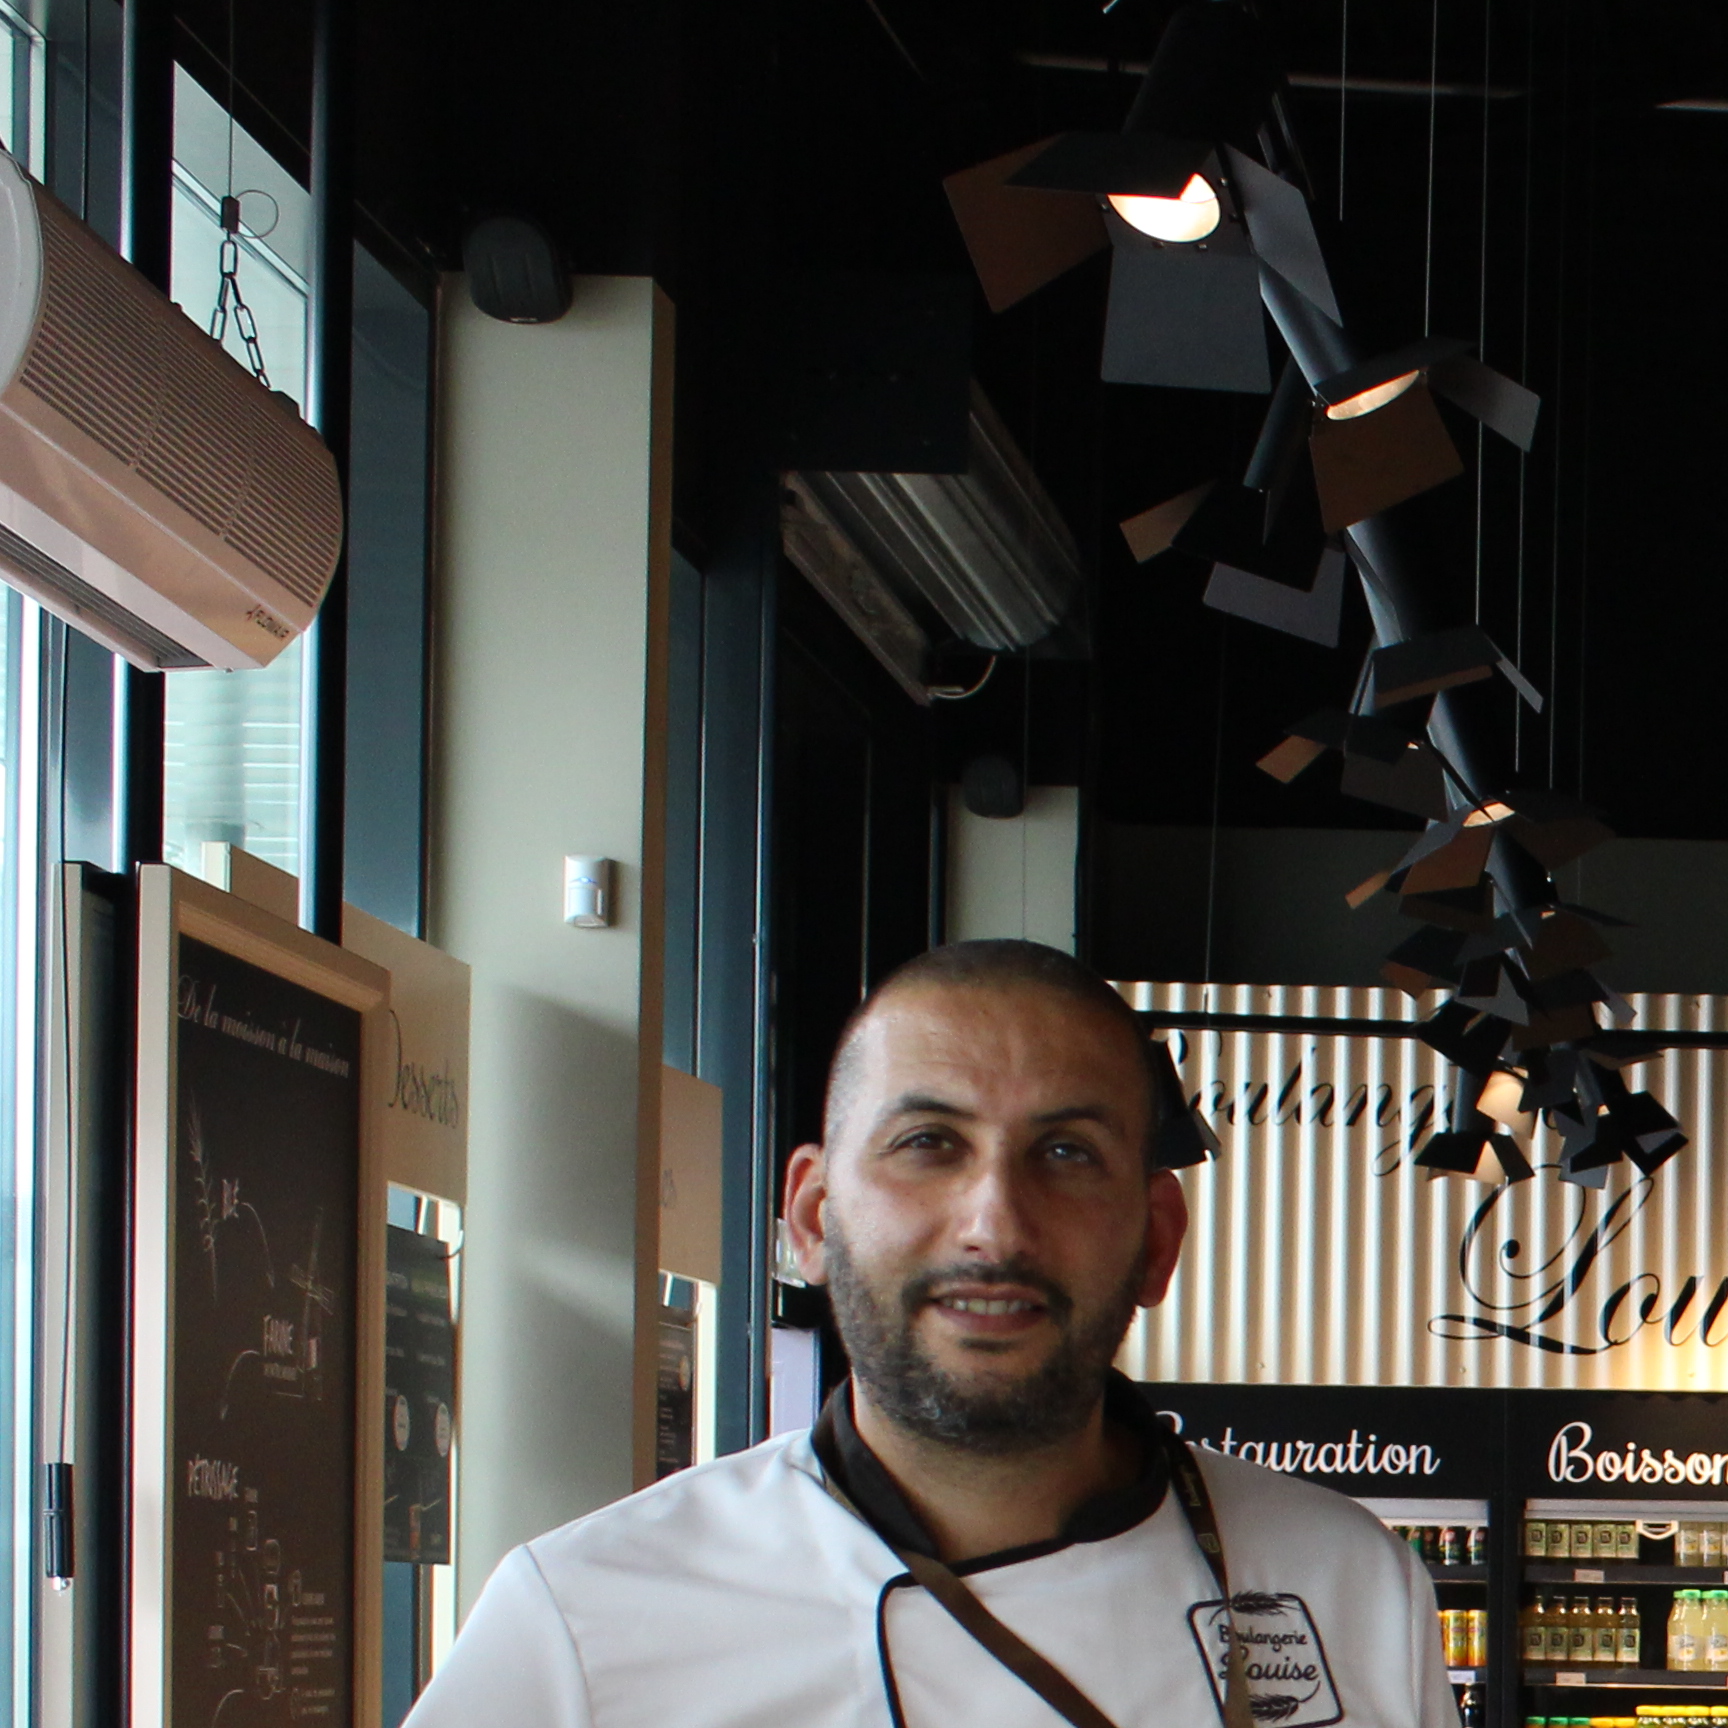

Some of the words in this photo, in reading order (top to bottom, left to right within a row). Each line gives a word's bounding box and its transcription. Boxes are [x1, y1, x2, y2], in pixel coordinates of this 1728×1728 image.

[204, 984, 219, 1029] la
[1155, 1410, 1441, 1475] stauration
[1219, 1624, 1308, 1653] Bulangerie
